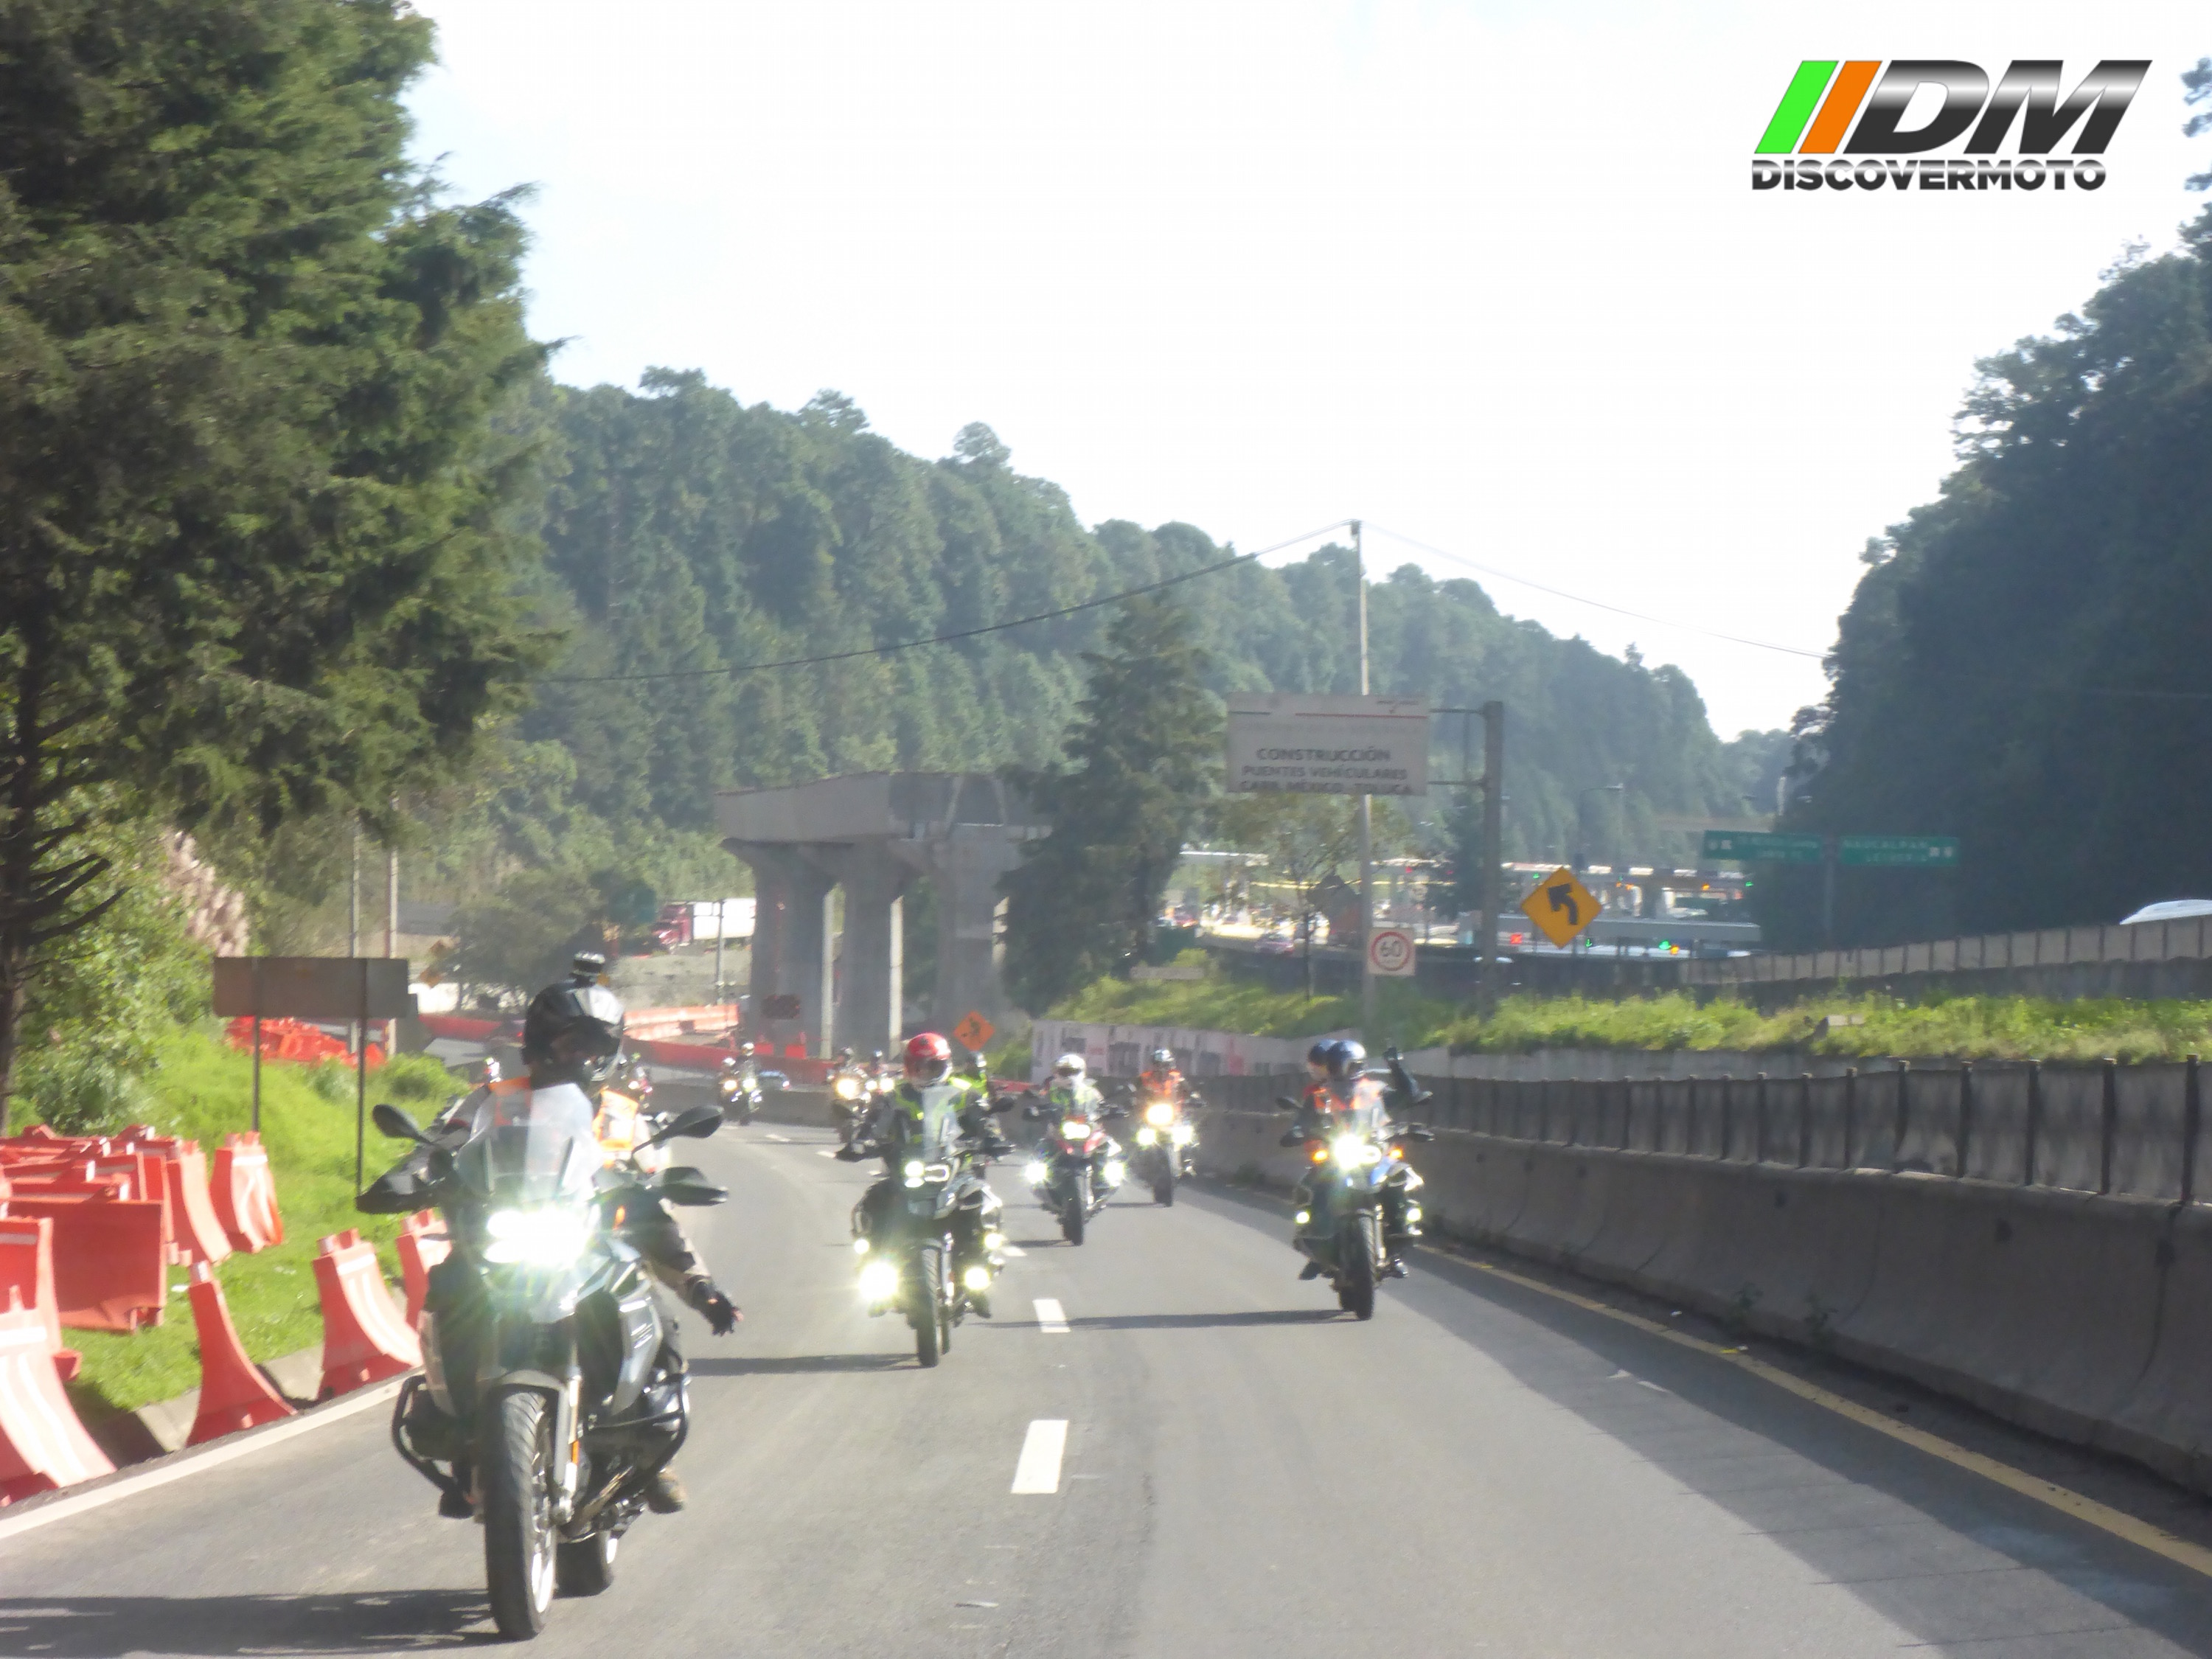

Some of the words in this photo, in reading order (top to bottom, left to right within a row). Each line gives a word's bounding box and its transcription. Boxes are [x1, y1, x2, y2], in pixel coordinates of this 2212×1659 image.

[1256, 745, 1391, 761] CONSTRUCCIÓN
[1241, 765, 1306, 776] PUENTES
[1380, 939, 1402, 957] 60
